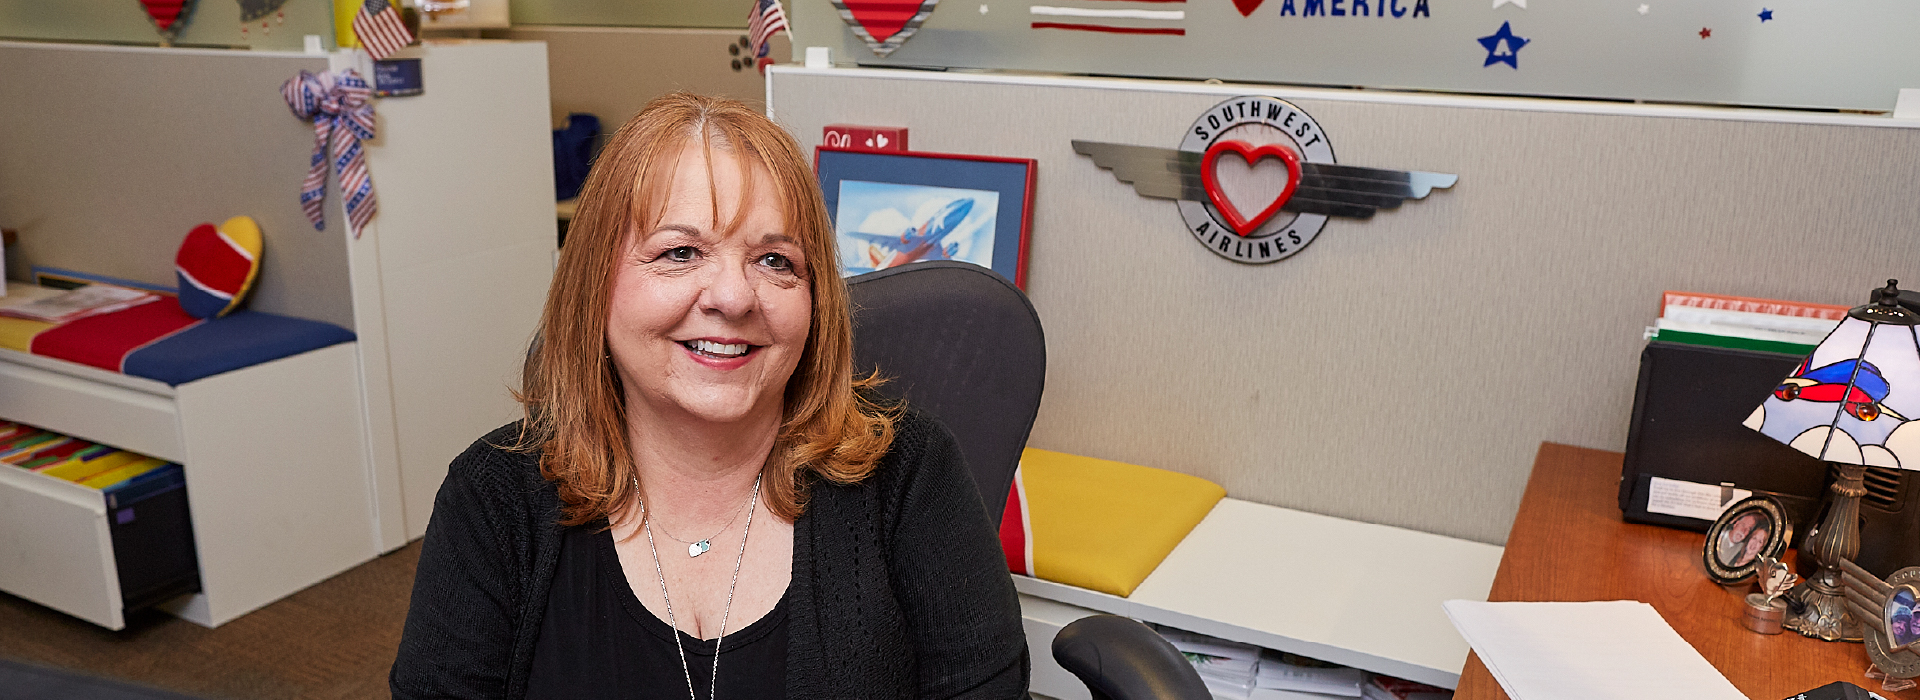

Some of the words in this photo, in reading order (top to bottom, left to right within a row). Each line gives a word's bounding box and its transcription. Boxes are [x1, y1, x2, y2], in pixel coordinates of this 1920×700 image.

[1280, 0, 1430, 18] AMERICA
[1195, 101, 1321, 147] SOUTHWEST
[1196, 221, 1302, 258] AIRLINES
